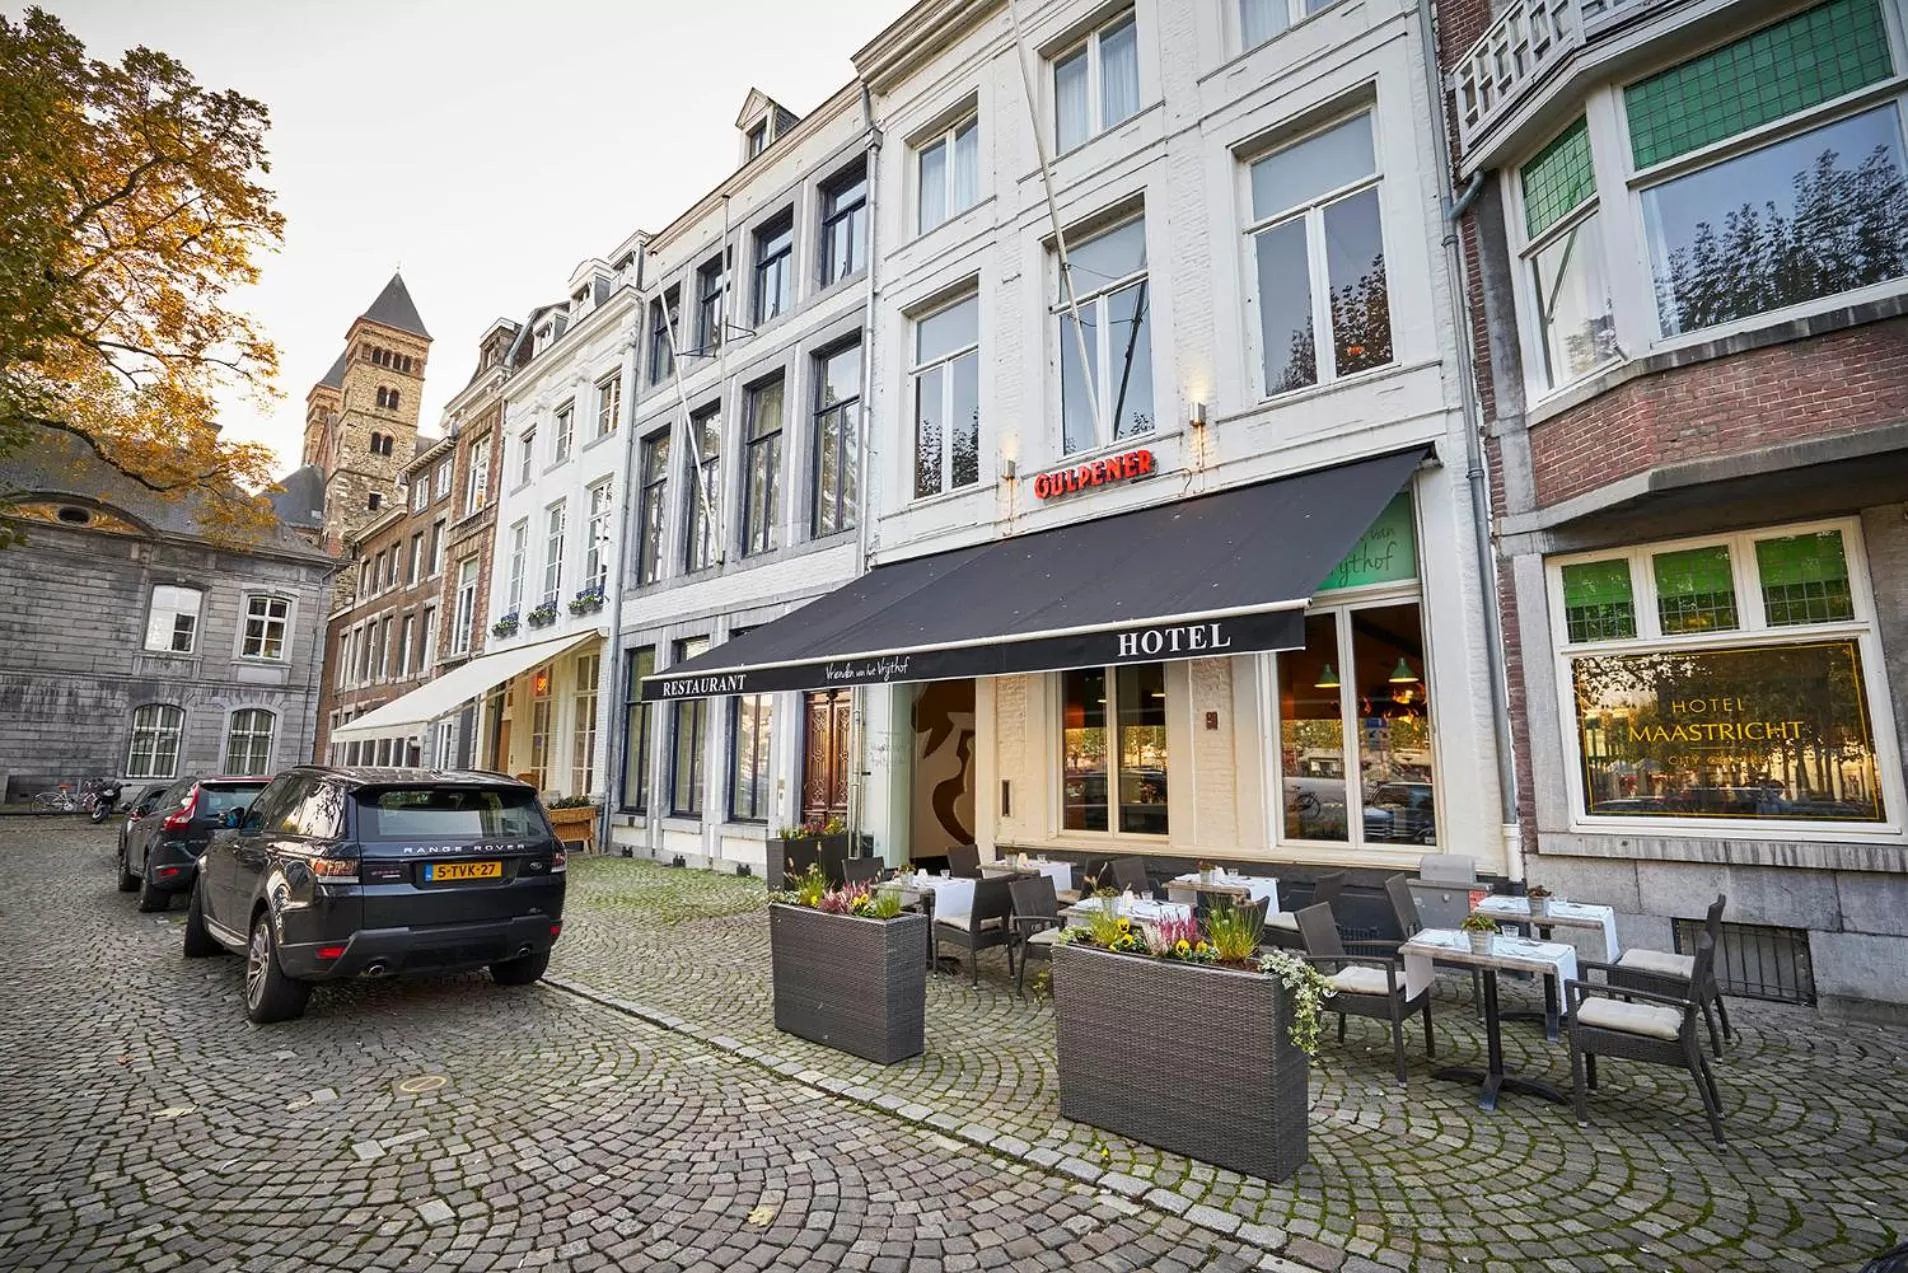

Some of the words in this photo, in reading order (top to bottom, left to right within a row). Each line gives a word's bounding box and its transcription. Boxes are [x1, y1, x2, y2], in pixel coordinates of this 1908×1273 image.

[1034, 450, 1154, 500] GULPENER
[1117, 623, 1231, 657] HOTEL
[663, 674, 747, 697] RESTAURANT
[1672, 698, 1745, 713] HOTEL
[1629, 721, 1804, 742] MAASTRICHT
[403, 846, 463, 854] RANGE
[438, 864, 496, 879] 5-TVK-27
